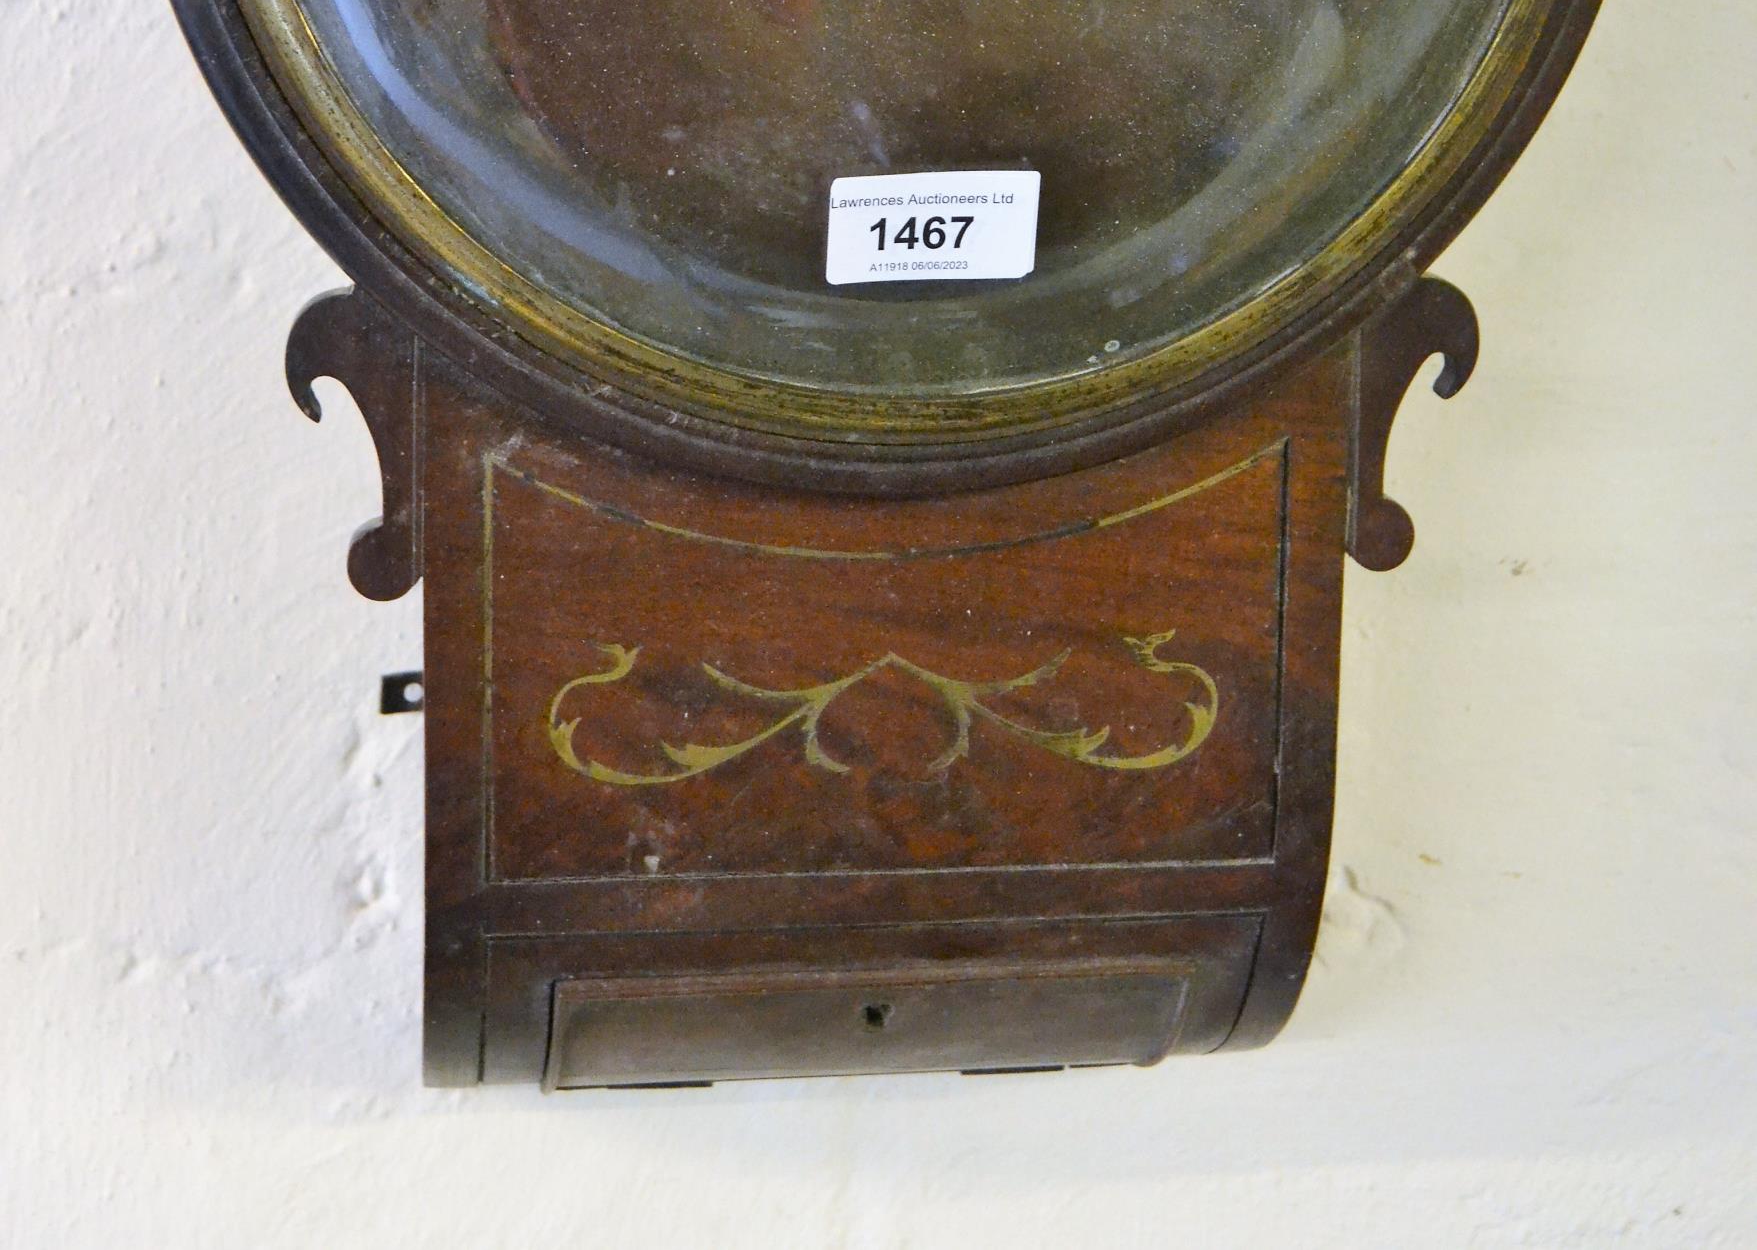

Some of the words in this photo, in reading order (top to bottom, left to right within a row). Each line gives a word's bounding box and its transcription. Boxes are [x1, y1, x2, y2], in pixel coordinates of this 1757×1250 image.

[831, 197, 904, 209] Lawrences
[907, 192, 988, 205] Auctioneers
[992, 192, 1014, 204] Ltd
[869, 215, 975, 251] 1467
[869, 262, 908, 272] A11918
[911, 260, 968, 271] 06/06/2023
